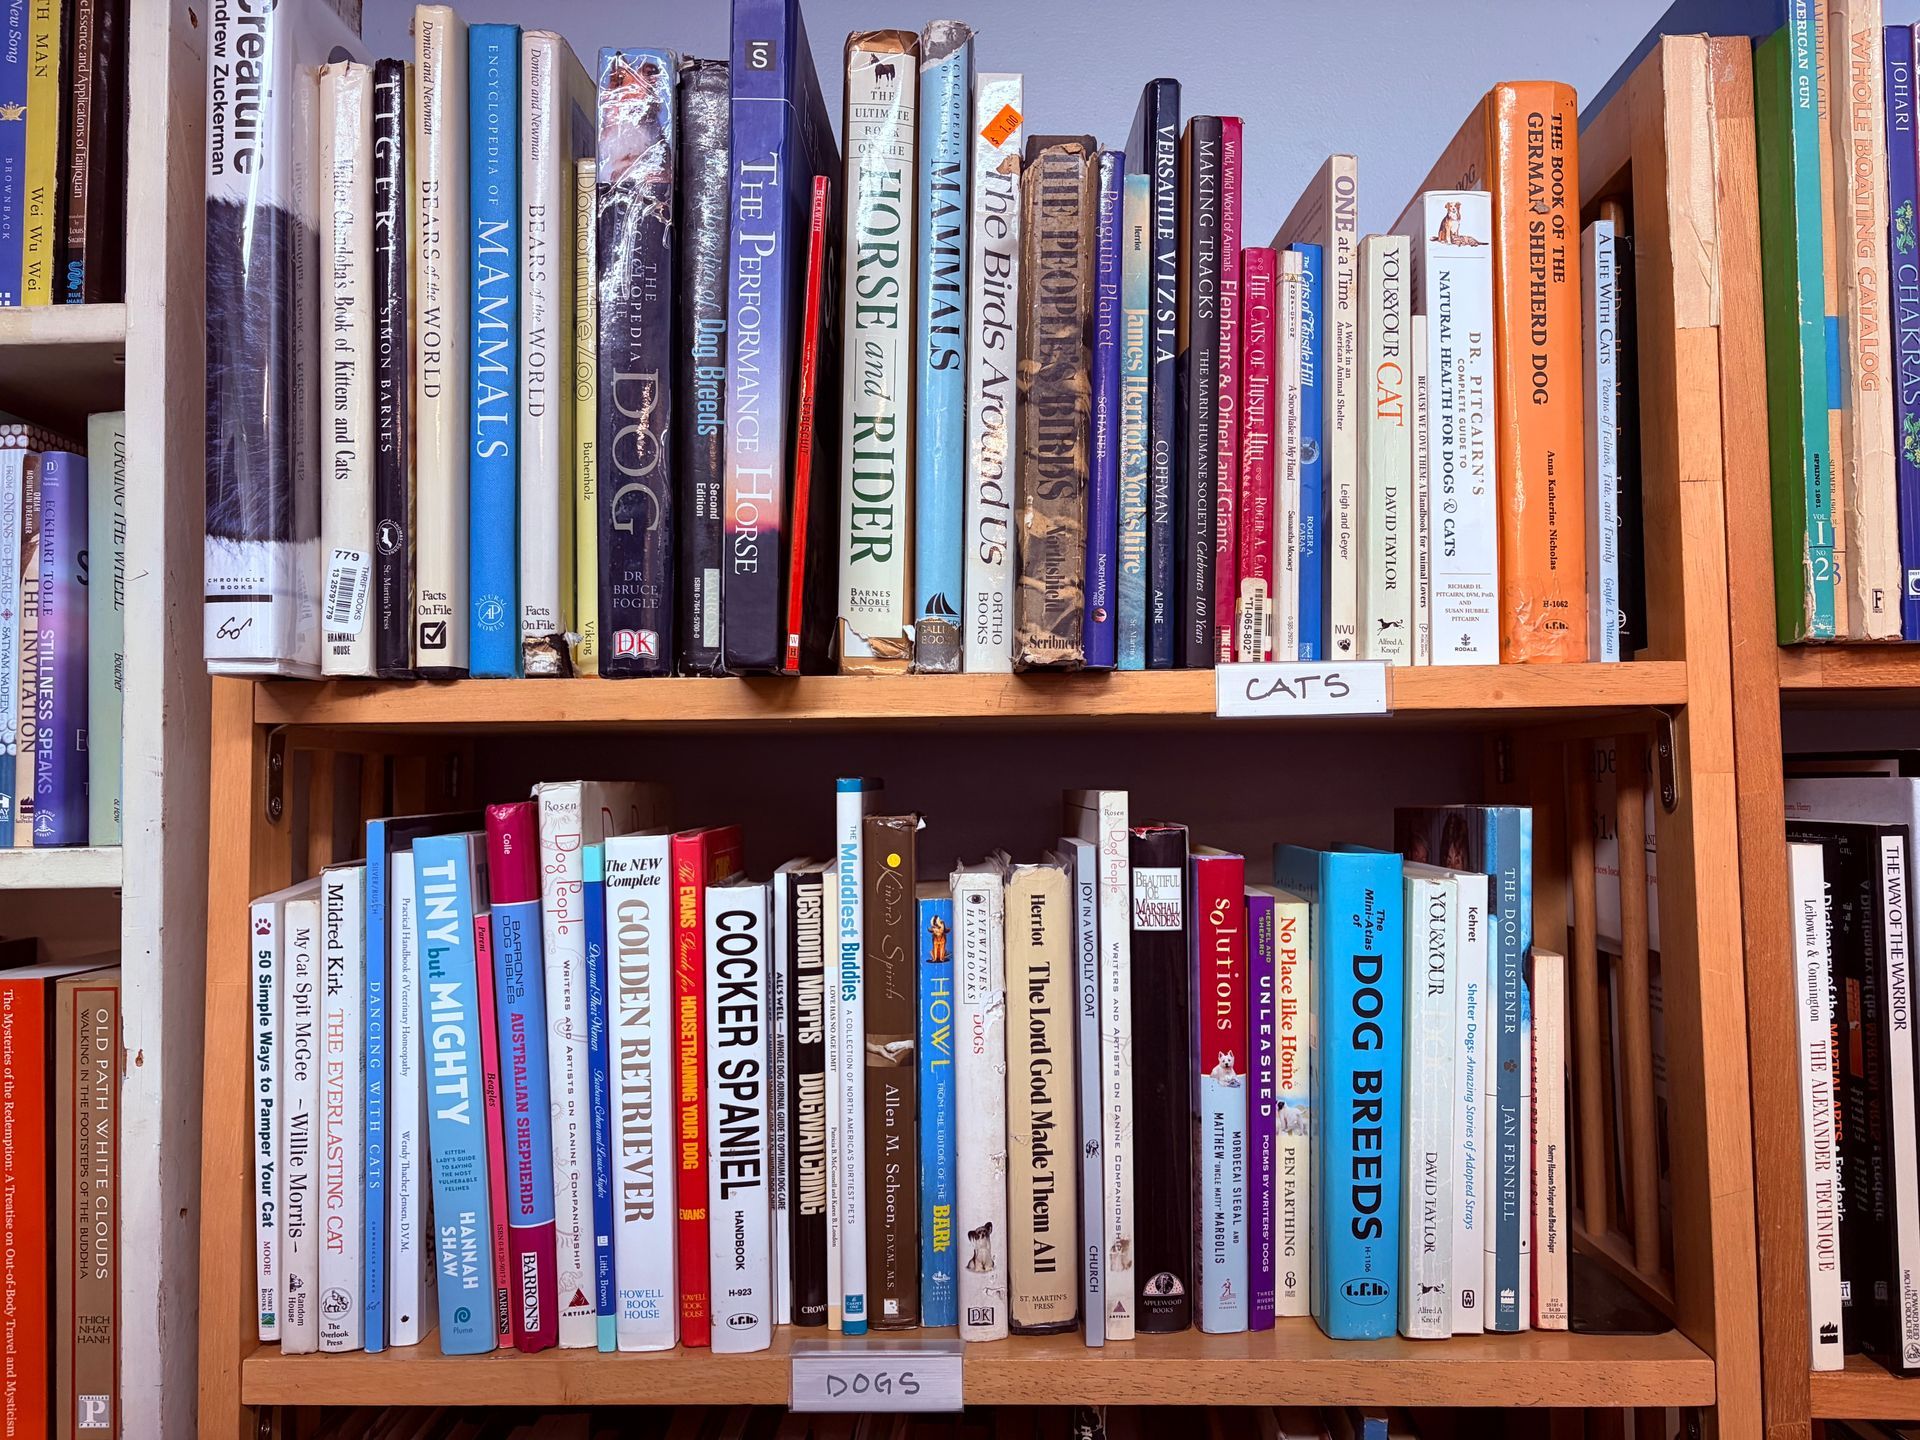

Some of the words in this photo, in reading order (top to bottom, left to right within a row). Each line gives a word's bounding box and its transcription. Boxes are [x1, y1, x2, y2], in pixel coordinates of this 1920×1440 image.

[531, 49, 542, 87] Domico
[488, 45, 499, 175] ENCYCLOPEDIA
[531, 89, 542, 111] and
[1891, 62, 1910, 132] JOHARI
[531, 114, 542, 161] Newman
[1551, 113, 1563, 150] THE
[375, 78, 395, 253] TIGER!
[1198, 140, 1214, 227] MAKING
[1551, 156, 1564, 209] BOOK
[2, 158, 13, 240] BROWNBACK
[488, 185, 499, 206] OF
[739, 152, 778, 221] THE
[1335, 175, 1355, 232] ONE
[422, 179, 440, 260] BEARS
[1134, 225, 1143, 251] Herriot
[1552, 214, 1564, 240] OF
[1338, 237, 1351, 253] at
[1338, 256, 1347, 265] a
[1552, 245, 1565, 283] THE
[425, 265, 439, 280] of
[426, 282, 439, 301] the
[1198, 236, 1214, 319] TRACKS
[1338, 269, 1353, 310] Time
[380, 308, 391, 368] SIMON
[423, 307, 441, 398] WORLD
[477, 220, 509, 458] MAMMALS
[734, 230, 776, 454] PERFORMANCE
[1469, 332, 1481, 364] DR.
[1457, 358, 1466, 415] COMPLETE
[380, 380, 392, 452] BARNES
[1458, 418, 1466, 451] GUIDE
[1469, 375, 1484, 496] PITCAIRN'S
[583, 441, 594, 501] Buchenholz
[611, 367, 659, 535] DOG
[1458, 455, 1467, 469] TO
[1547, 450, 1556, 476] Anna
[1813, 453, 1821, 486] SPRING
[695, 483, 706, 517] Edition
[709, 483, 720, 519] Second
[1155, 440, 1169, 524] COFFMAN
[1339, 483, 1350, 510] Leigh
[1547, 479, 1558, 526] Katherine
[734, 464, 773, 575] HORSE
[1340, 512, 1350, 529] and
[1385, 486, 1397, 531] DAVID
[43, 500, 56, 565] ECKHART
[1338, 532, 1350, 560] Geyer
[1548, 529, 1559, 570] Nicholas
[332, 568, 340, 577] 13
[335, 550, 360, 562] 779
[1384, 534, 1397, 591] TAYLOR
[43, 570, 54, 616] TOLLE
[328, 579, 338, 603] 25797
[353, 566, 370, 620] THRIFTBOOKS
[421, 590, 447, 601] Facts
[613, 585, 658, 595] BRUCE
[613, 598, 660, 609] FOGLE
[1154, 590, 1164, 623] ALPINE
[326, 605, 334, 620] 779
[977, 592, 988, 645] BOOKS
[991, 591, 1003, 645] ORTHO
[582, 621, 595, 655] Viking
[1246, 673, 1350, 700] CATS
[605, 860, 629, 872] The
[631, 858, 661, 871] NEW
[1886, 846, 1900, 875] THE
[1080, 882, 1093, 904] JOY
[1504, 868, 1516, 902] THE
[1888, 877, 1902, 910] WAY
[327, 884, 343, 950] Mildred
[1082, 906, 1091, 917] IN
[1083, 919, 1091, 927] A
[1352, 914, 1362, 927] of
[1364, 888, 1374, 951] Mini-Atlas
[1376, 909, 1385, 931] The
[1468, 907, 1478, 942] Kehret
[1504, 909, 1516, 947] DOG
[1803, 899, 1819, 946] Leibowitz
[1889, 910, 1902, 932] OF
[502, 916, 511, 949] DOG
[1890, 932, 1904, 960] THE
[258, 950, 271, 969] 50
[512, 921, 524, 998] BARRON'S
[617, 899, 651, 1028] GOLDEN
[966, 908, 976, 1000] HANDBOOKS
[1082, 930, 1094, 983] WOOLLY
[1806, 950, 1818, 958] &
[327, 956, 343, 997] Kirk
[504, 953, 515, 1004] BIBLES
[716, 910, 759, 1048] COCKER
[1504, 953, 1516, 1034] LISTENER
[1805, 962, 1820, 1022] Connington
[1891, 962, 1907, 1031] WARRIOR
[257, 974, 272, 1026] Simple
[1084, 985, 1095, 1018] COAT
[1352, 954, 1383, 1051] DOG
[1467, 983, 1477, 1021] Shelter
[80, 1009, 89, 1065] WALKING
[96, 1009, 108, 1051] OLD
[369, 982, 381, 1069] DANCING
[830, 1022, 836, 1030] NO
[1464, 1023, 1476, 1054] Dogs:
[257, 1032, 272, 1072] Ways
[1259, 976, 1271, 1117] UNLEASHED
[80, 1069, 89, 1081] IN
[96, 1059, 108, 1110] PATH
[260, 1077, 273, 1093] to
[1463, 1056, 1476, 1102] Amazing
[80, 1085, 89, 1108] THE
[369, 1081, 380, 1131] WITH
[259, 1098, 274, 1156] Pamper
[621, 1036, 655, 1223] RETRIEVER
[719, 1059, 760, 1200] SPANIEL
[1465, 1105, 1476, 1138] Stories
[1501, 1105, 1515, 1137] JAN
[79, 1112, 89, 1178] FOOTSTEPS
[96, 1118, 108, 1189] WHITE
[1284, 1147, 1295, 1176] PEN
[1352, 1070, 1382, 1240] BREEDS
[1464, 1140, 1476, 1152] of
[261, 1162, 274, 1199] Your
[369, 1144, 380, 1189] CATS
[1425, 1152, 1438, 1196] DAVID
[1464, 1153, 1476, 1197] Adopted
[1503, 1144, 1515, 1221] FENNELL
[80, 1181, 89, 1197] OF
[79, 1200, 89, 1223] THE
[261, 1201, 275, 1227] Cat
[1284, 1181, 1296, 1257] FARTHING
[1424, 1198, 1437, 1254] TAYLOR
[1464, 1199, 1475, 1230] Strays
[79, 1227, 89, 1280] BUDDHA
[95, 1196, 108, 1280] CLOUDS
[263, 1241, 272, 1276] MOORE
[734, 1210, 745, 1271] HANDBOOK
[1088, 1245, 1099, 1293] CHURCH
[498, 1288, 509, 1334] BARRON'S
[523, 1254, 539, 1332] BARRON'S
[78, 1316, 110, 1325] THICH
[78, 1325, 108, 1334] NHAT
[624, 1311, 660, 1319] HOUSE
[826, 1372, 920, 1397] DOGS
